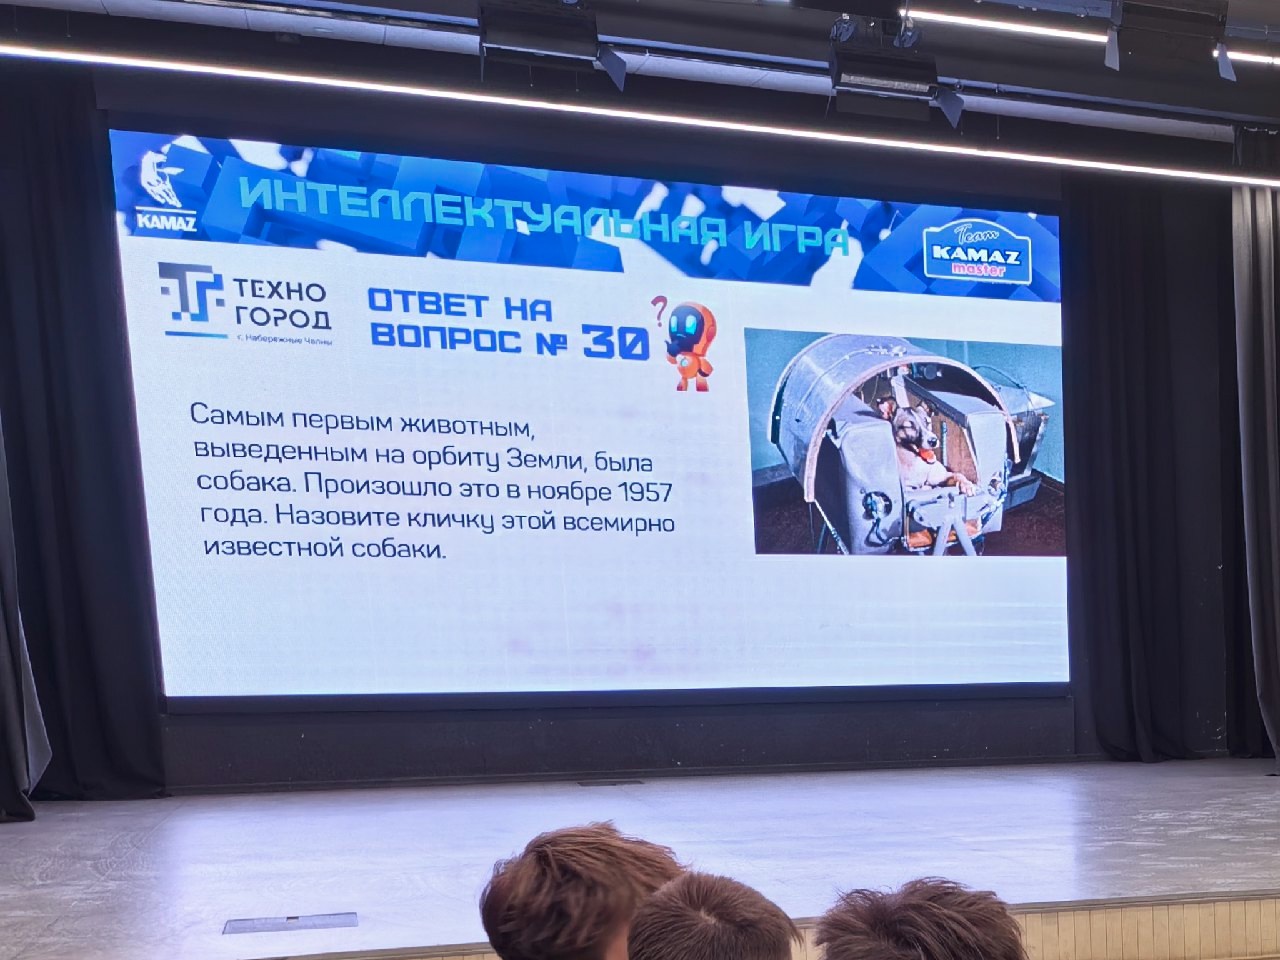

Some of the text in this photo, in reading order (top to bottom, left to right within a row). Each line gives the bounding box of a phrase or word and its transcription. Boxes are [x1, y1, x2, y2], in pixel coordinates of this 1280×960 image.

[136, 213, 198, 233] KAMAZ
[239, 176, 850, 257] ИНТЕЛЛЕКТУАЛЬНАЯ ИГРА
[954, 223, 1000, 245] Team
[932, 245, 1021, 265] KAMAZ
[952, 262, 1006, 277] master
[233, 278, 327, 303] ТЕХНО
[367, 287, 552, 322] ОТВЕТ НА
[235, 305, 332, 330] ГОРОД
[371, 321, 650, 361] ВОПРОС № 30
[190, 402, 535, 441] Самым первым животным,
[194, 441, 653, 474] выведенным на орбиту Земли, была
[197, 472, 673, 505] собака. Произошло это в ноябре 1957
[201, 504, 675, 537] года. Назовите кличку этой всемирно
[204, 537, 446, 560] известной собаки.
